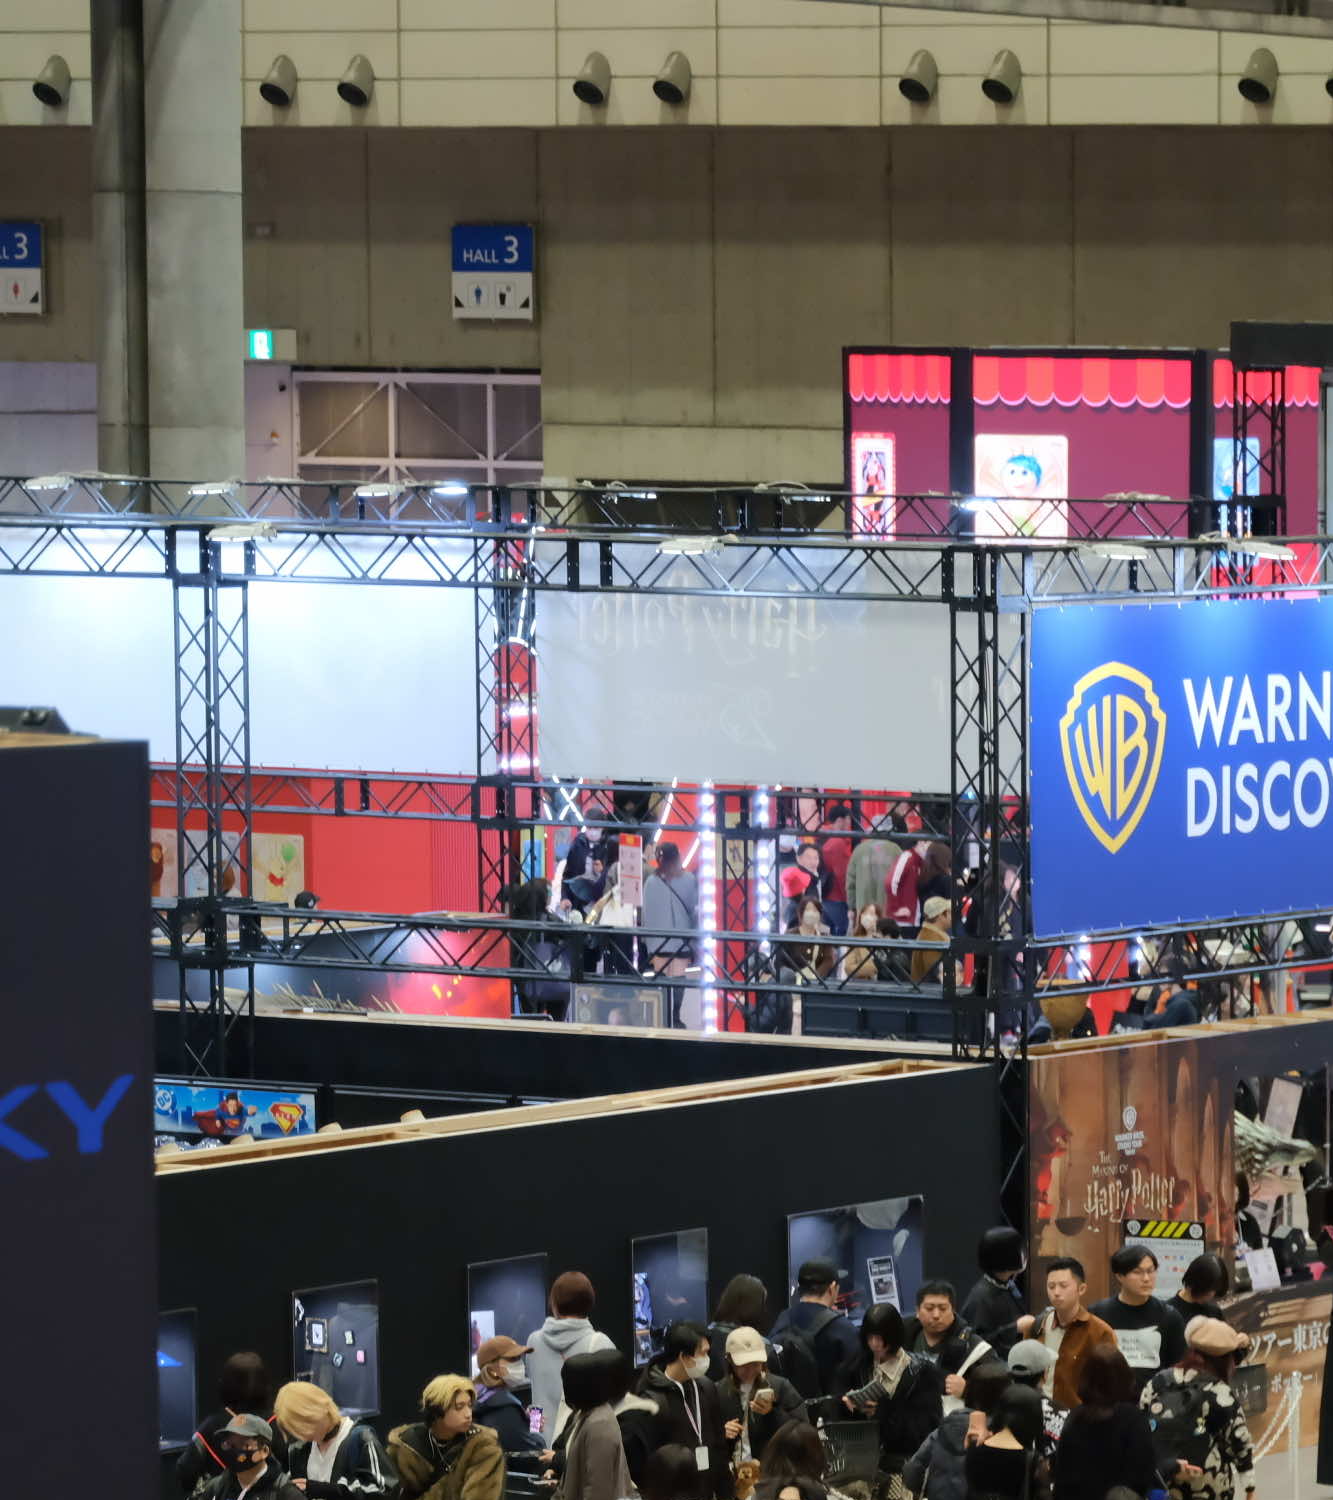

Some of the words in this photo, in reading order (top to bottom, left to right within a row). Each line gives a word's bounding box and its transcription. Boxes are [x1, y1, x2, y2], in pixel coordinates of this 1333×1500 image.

[13, 231, 29, 260] 3
[462, 247, 499, 264] HALL
[503, 234, 520, 264] 3
